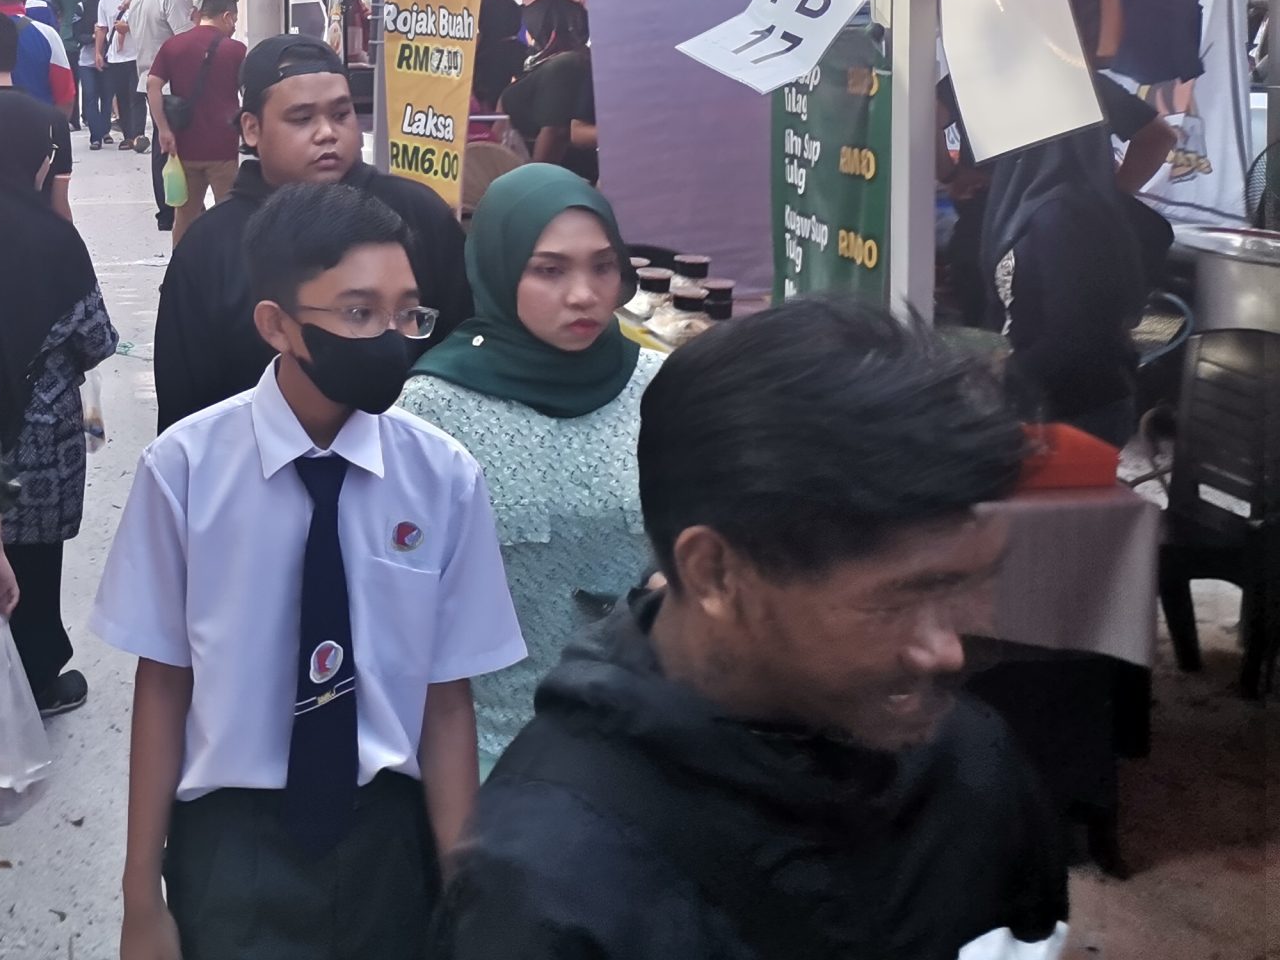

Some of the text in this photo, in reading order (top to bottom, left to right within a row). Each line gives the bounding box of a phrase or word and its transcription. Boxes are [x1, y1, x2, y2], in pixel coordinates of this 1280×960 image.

[384, 2, 474, 41] Rojak Buah
[731, 24, 804, 65] 17
[401, 103, 454, 143] Laksa
[389, 141, 459, 181] RM6.00
